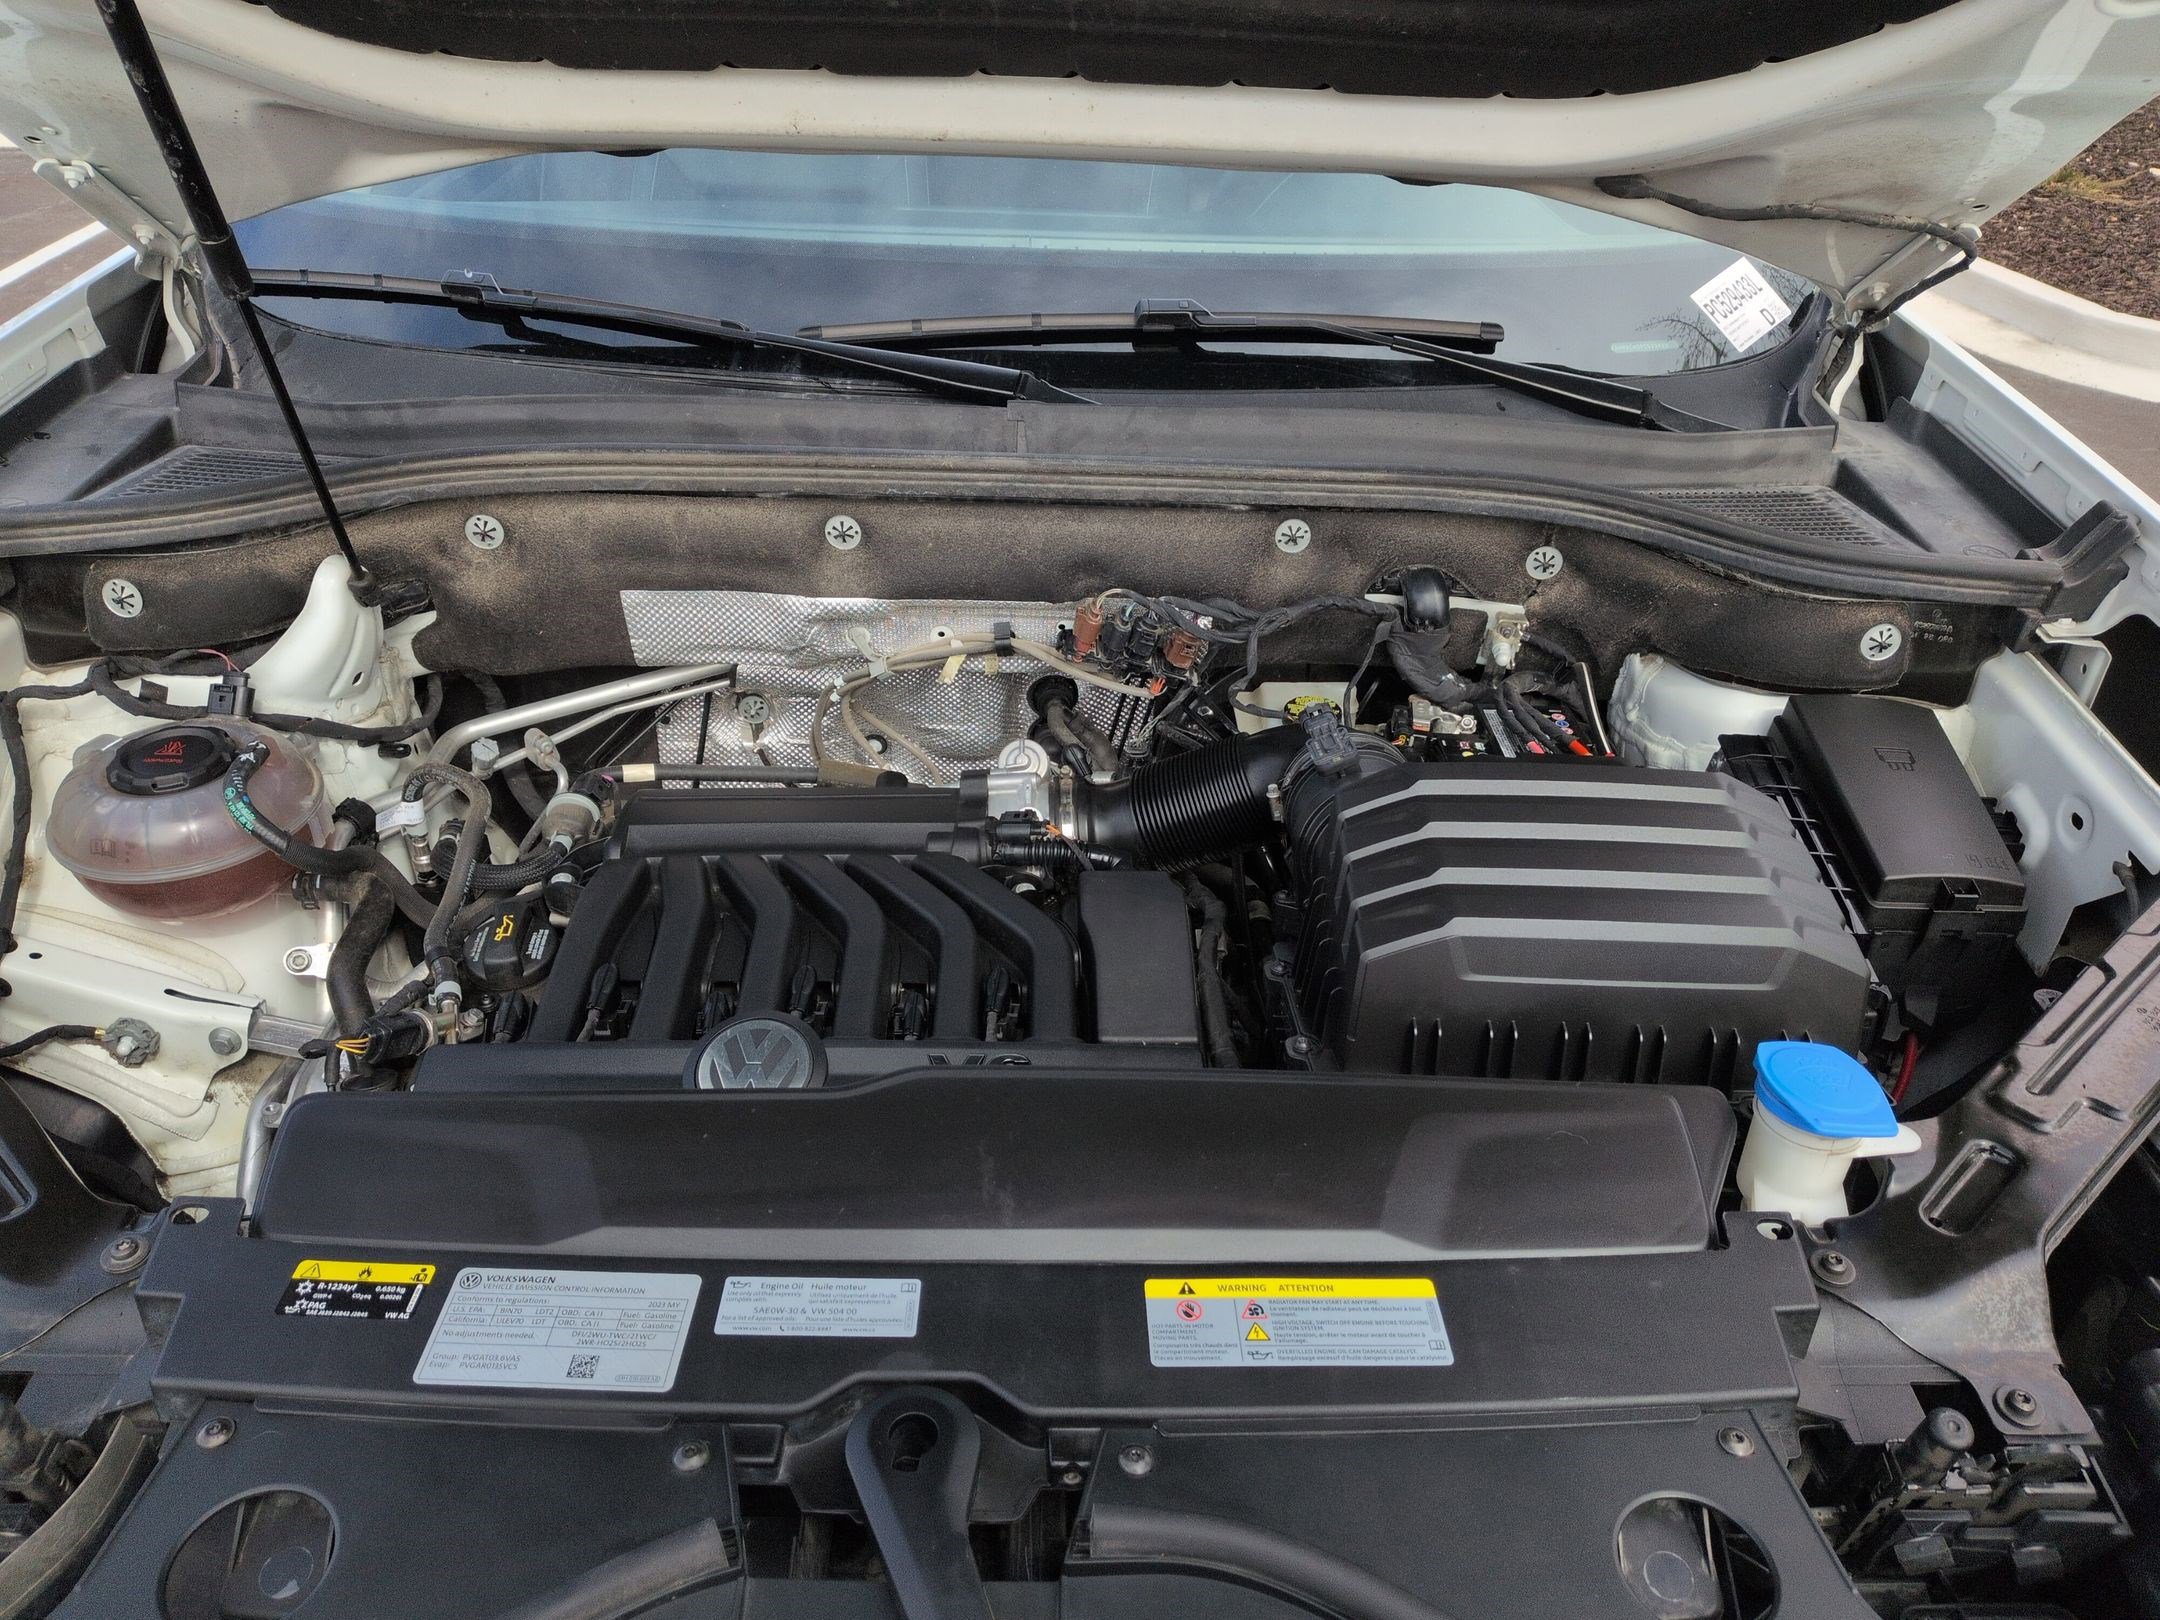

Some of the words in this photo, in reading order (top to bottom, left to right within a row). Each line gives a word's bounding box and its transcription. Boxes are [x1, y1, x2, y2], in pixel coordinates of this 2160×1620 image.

[1760, 308, 1776, 326] D
[487, 1275, 556, 1283] VOLKSWAGEN
[317, 1282, 358, 1291] R-1234yf
[553, 1285, 589, 1293] CONTROL
[591, 1286, 645, 1294] INFORMATION
[761, 1281, 789, 1291] Engine
[791, 1282, 804, 1290] Oil
[1217, 1283, 1267, 1293] WARNING
[1279, 1284, 1334, 1293] ATTENTION
[308, 1301, 326, 1309] PAG
[644, 1312, 677, 1320] Gasoline
[641, 1322, 674, 1330] Gasoline
[455, 1329, 503, 1339] adjustments
